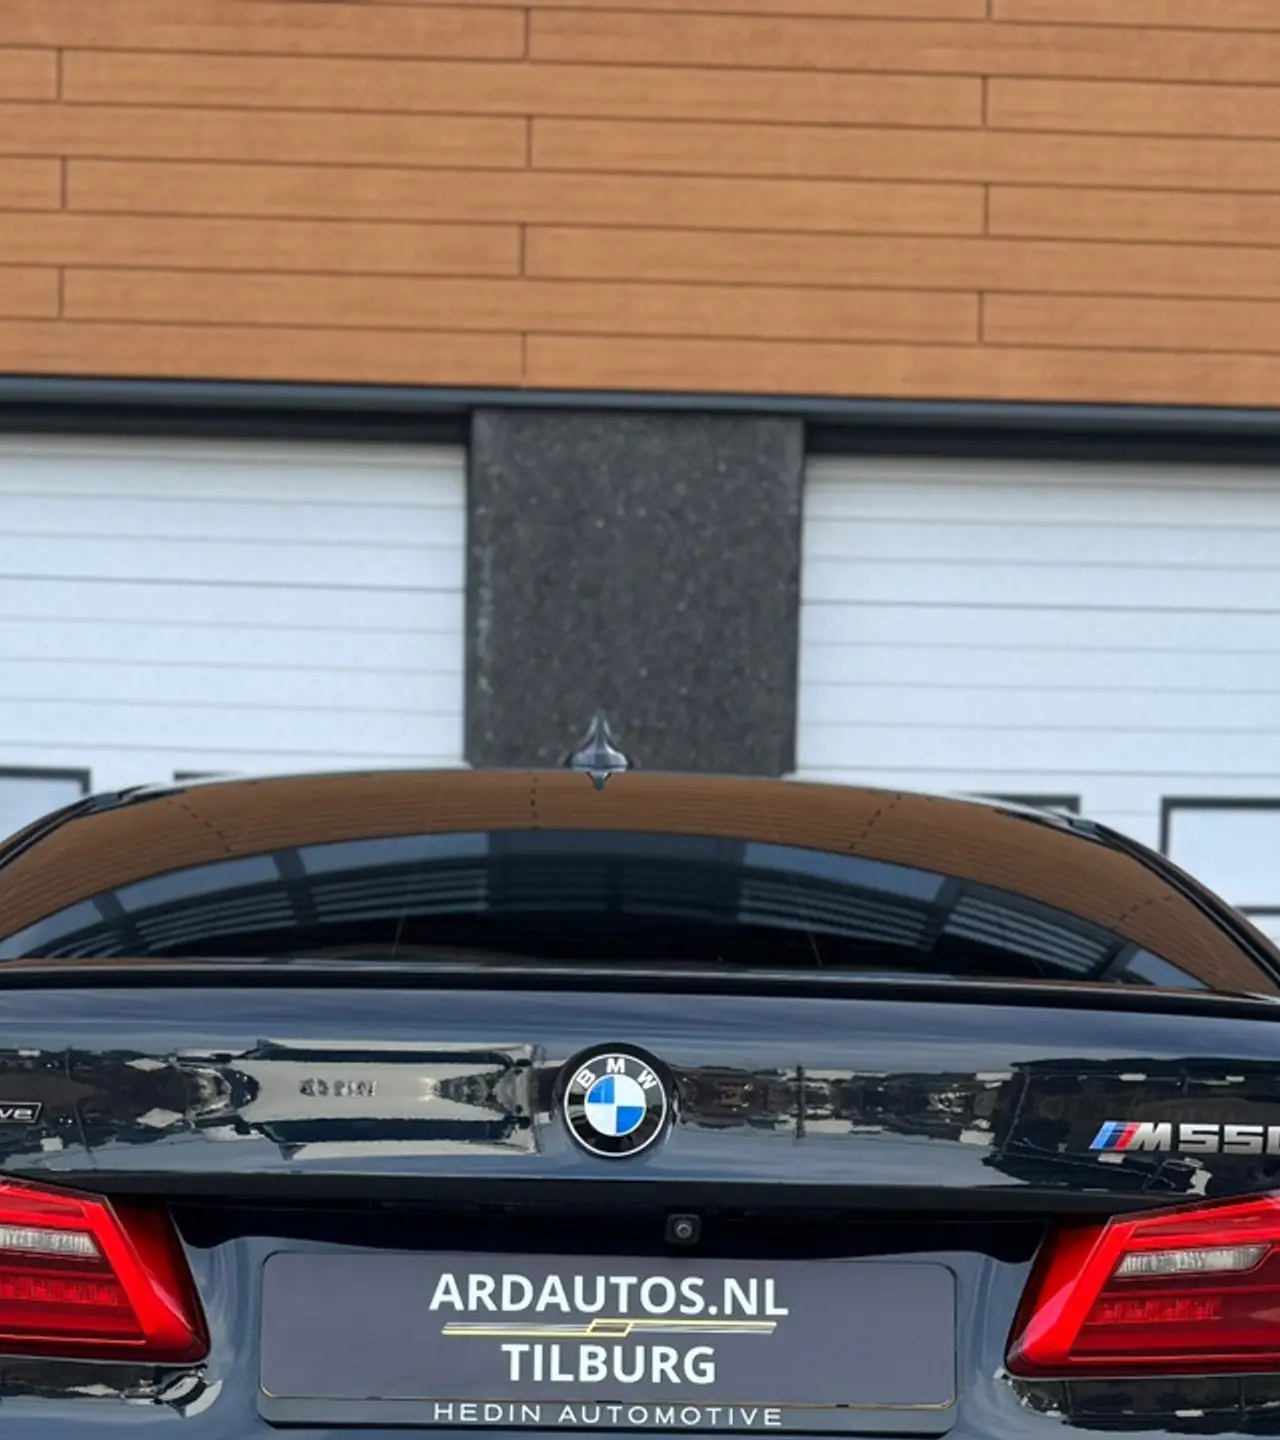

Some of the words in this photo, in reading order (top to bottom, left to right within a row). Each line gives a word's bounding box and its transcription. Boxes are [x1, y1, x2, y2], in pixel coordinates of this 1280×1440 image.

[576, 1058, 658, 1090] BMW
[429, 1273, 789, 1316] ARDAUTOS.NL
[501, 1343, 715, 1385] TILBURG
[434, 1403, 541, 1423] HEDIN
[558, 1404, 782, 1426] AUTOMOTIVE
